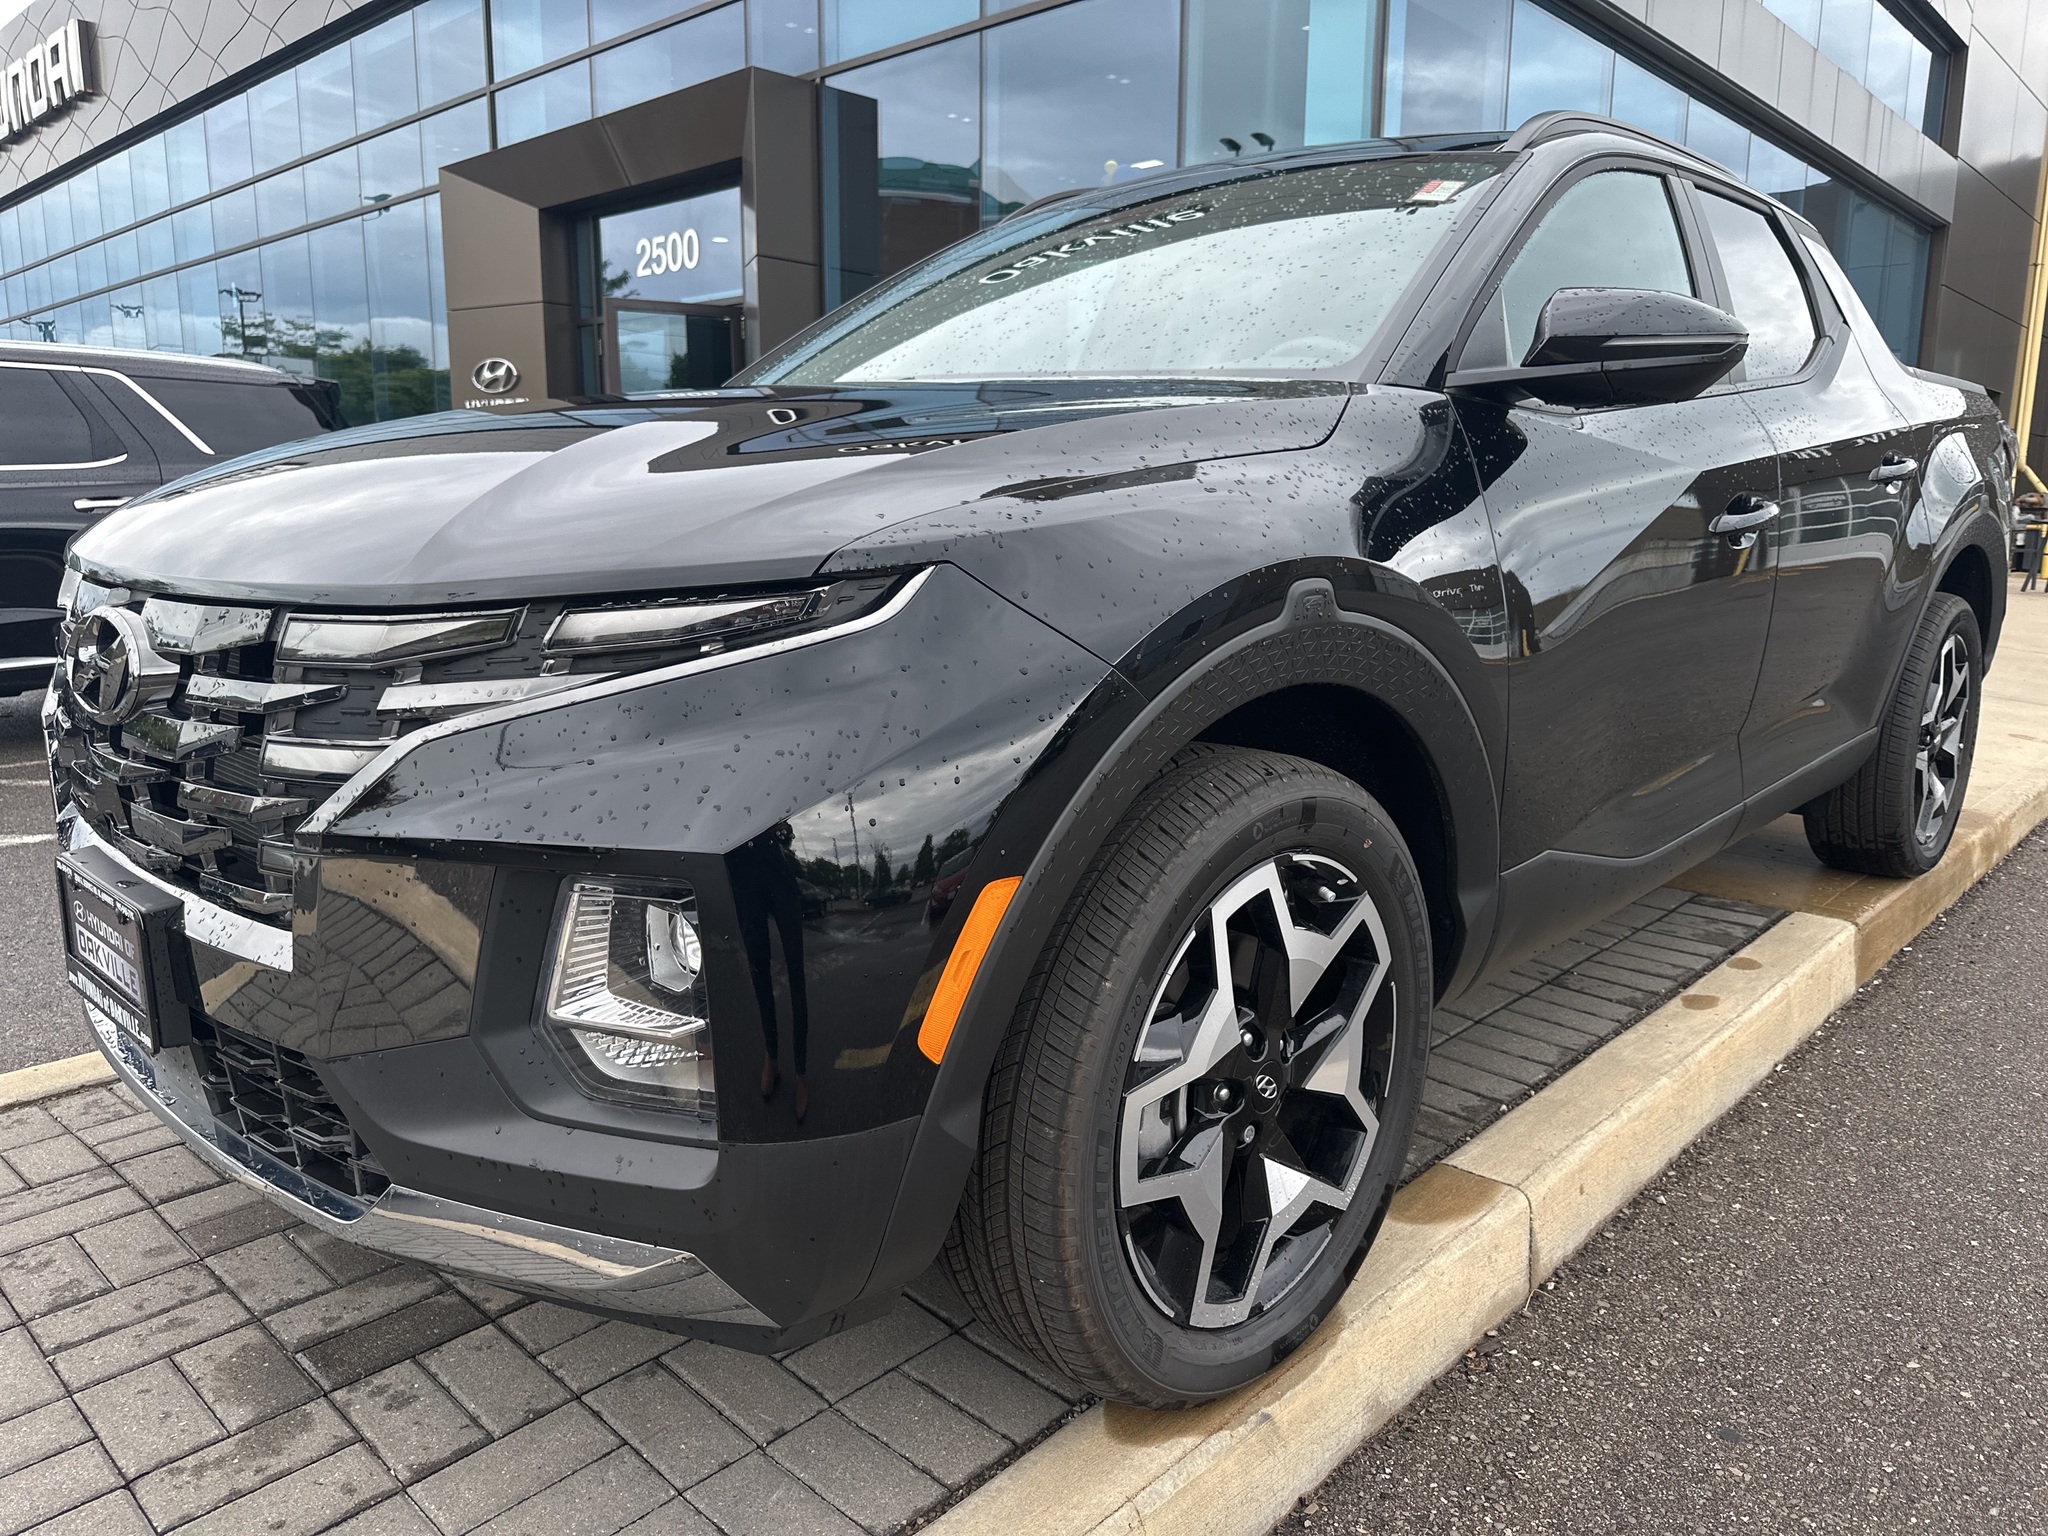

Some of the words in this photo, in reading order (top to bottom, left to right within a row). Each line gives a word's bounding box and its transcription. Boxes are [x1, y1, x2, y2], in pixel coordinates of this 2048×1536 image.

[636, 228, 699, 278] 2500
[78, 929, 139, 997] OAKVILLE
[86, 909, 124, 952] HYUNDAI
[124, 938, 135, 960] OF
[1403, 891, 1429, 1050] MICHELIN
[1096, 1147, 1134, 1337] MICHELIN
